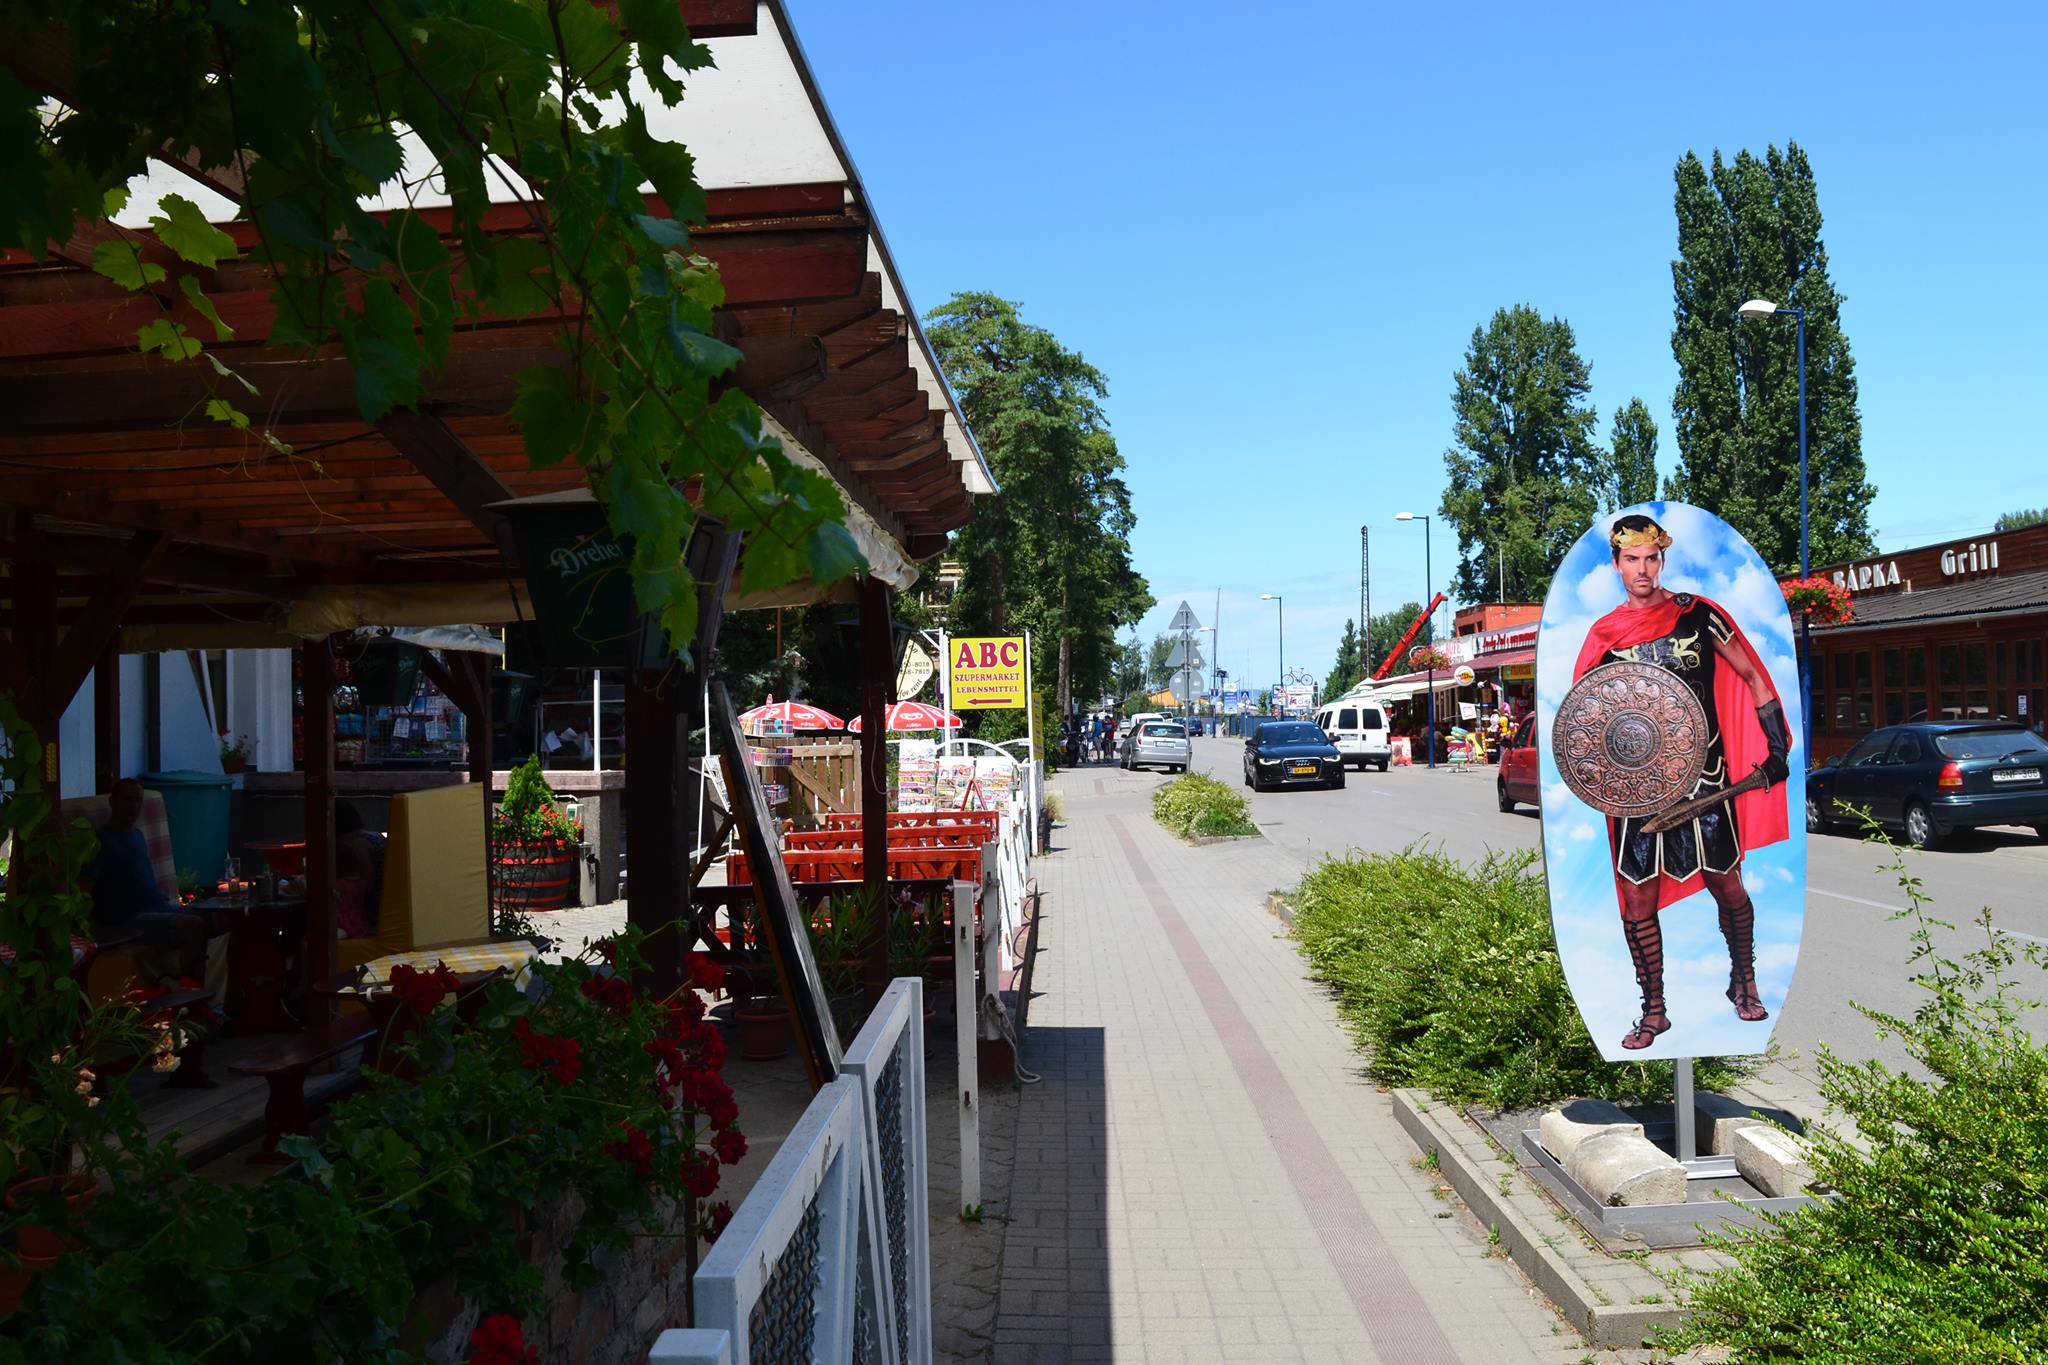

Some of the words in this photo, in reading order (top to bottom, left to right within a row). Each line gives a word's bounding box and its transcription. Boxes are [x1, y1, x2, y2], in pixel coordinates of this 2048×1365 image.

[1833, 561, 1901, 592] BÁRKA
[1941, 542, 1999, 576] Grill
[955, 641, 1019, 668] ABC
[955, 673, 1020, 682] SZUPERMARKET
[956, 686, 1020, 694] LEBENSMITTEL
